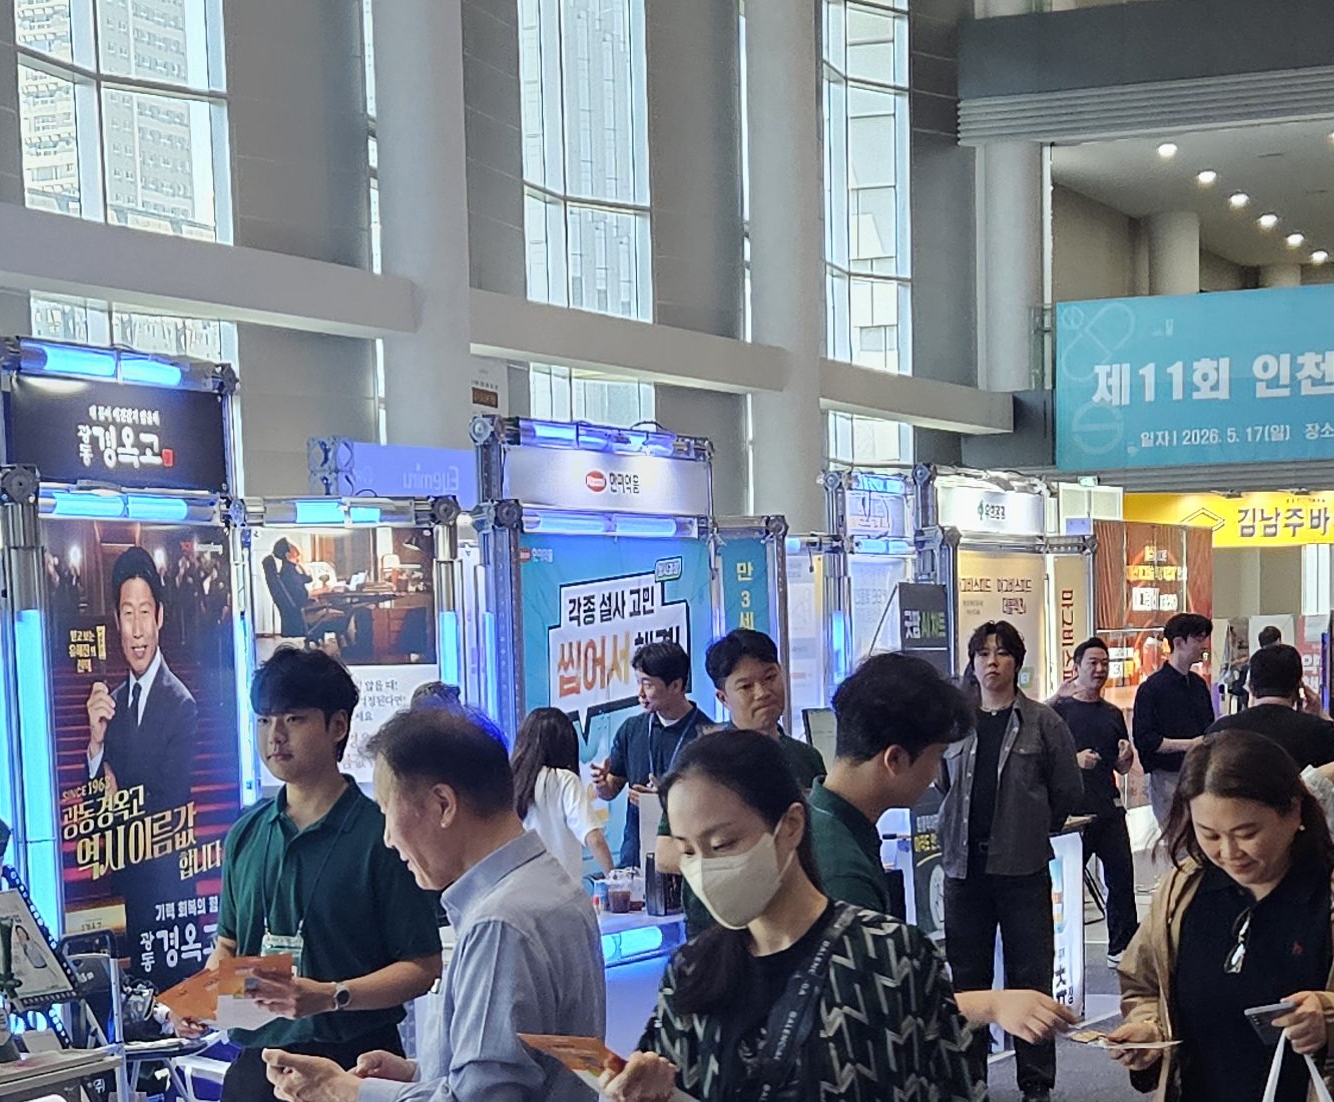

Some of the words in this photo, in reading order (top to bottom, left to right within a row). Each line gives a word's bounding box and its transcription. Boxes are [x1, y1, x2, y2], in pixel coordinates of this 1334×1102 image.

[1092, 357, 1231, 407] 제11회
[91, 424, 164, 469] 경옥고
[1140, 431, 1170, 449] 일자
[1182, 428, 1219, 446] 2026.
[1227, 428, 1240, 444] 5.
[1246, 424, 1291, 444] 17(일)
[1305, 423, 1334, 441] 장소
[736, 561, 754, 582] 만
[568, 594, 596, 627] 각종
[599, 589, 626, 623] 설사
[629, 585, 655, 617] 고민
[62, 784, 88, 801] SINCE
[179, 840, 223, 881] 합니다
[155, 901, 176, 922] 기력
